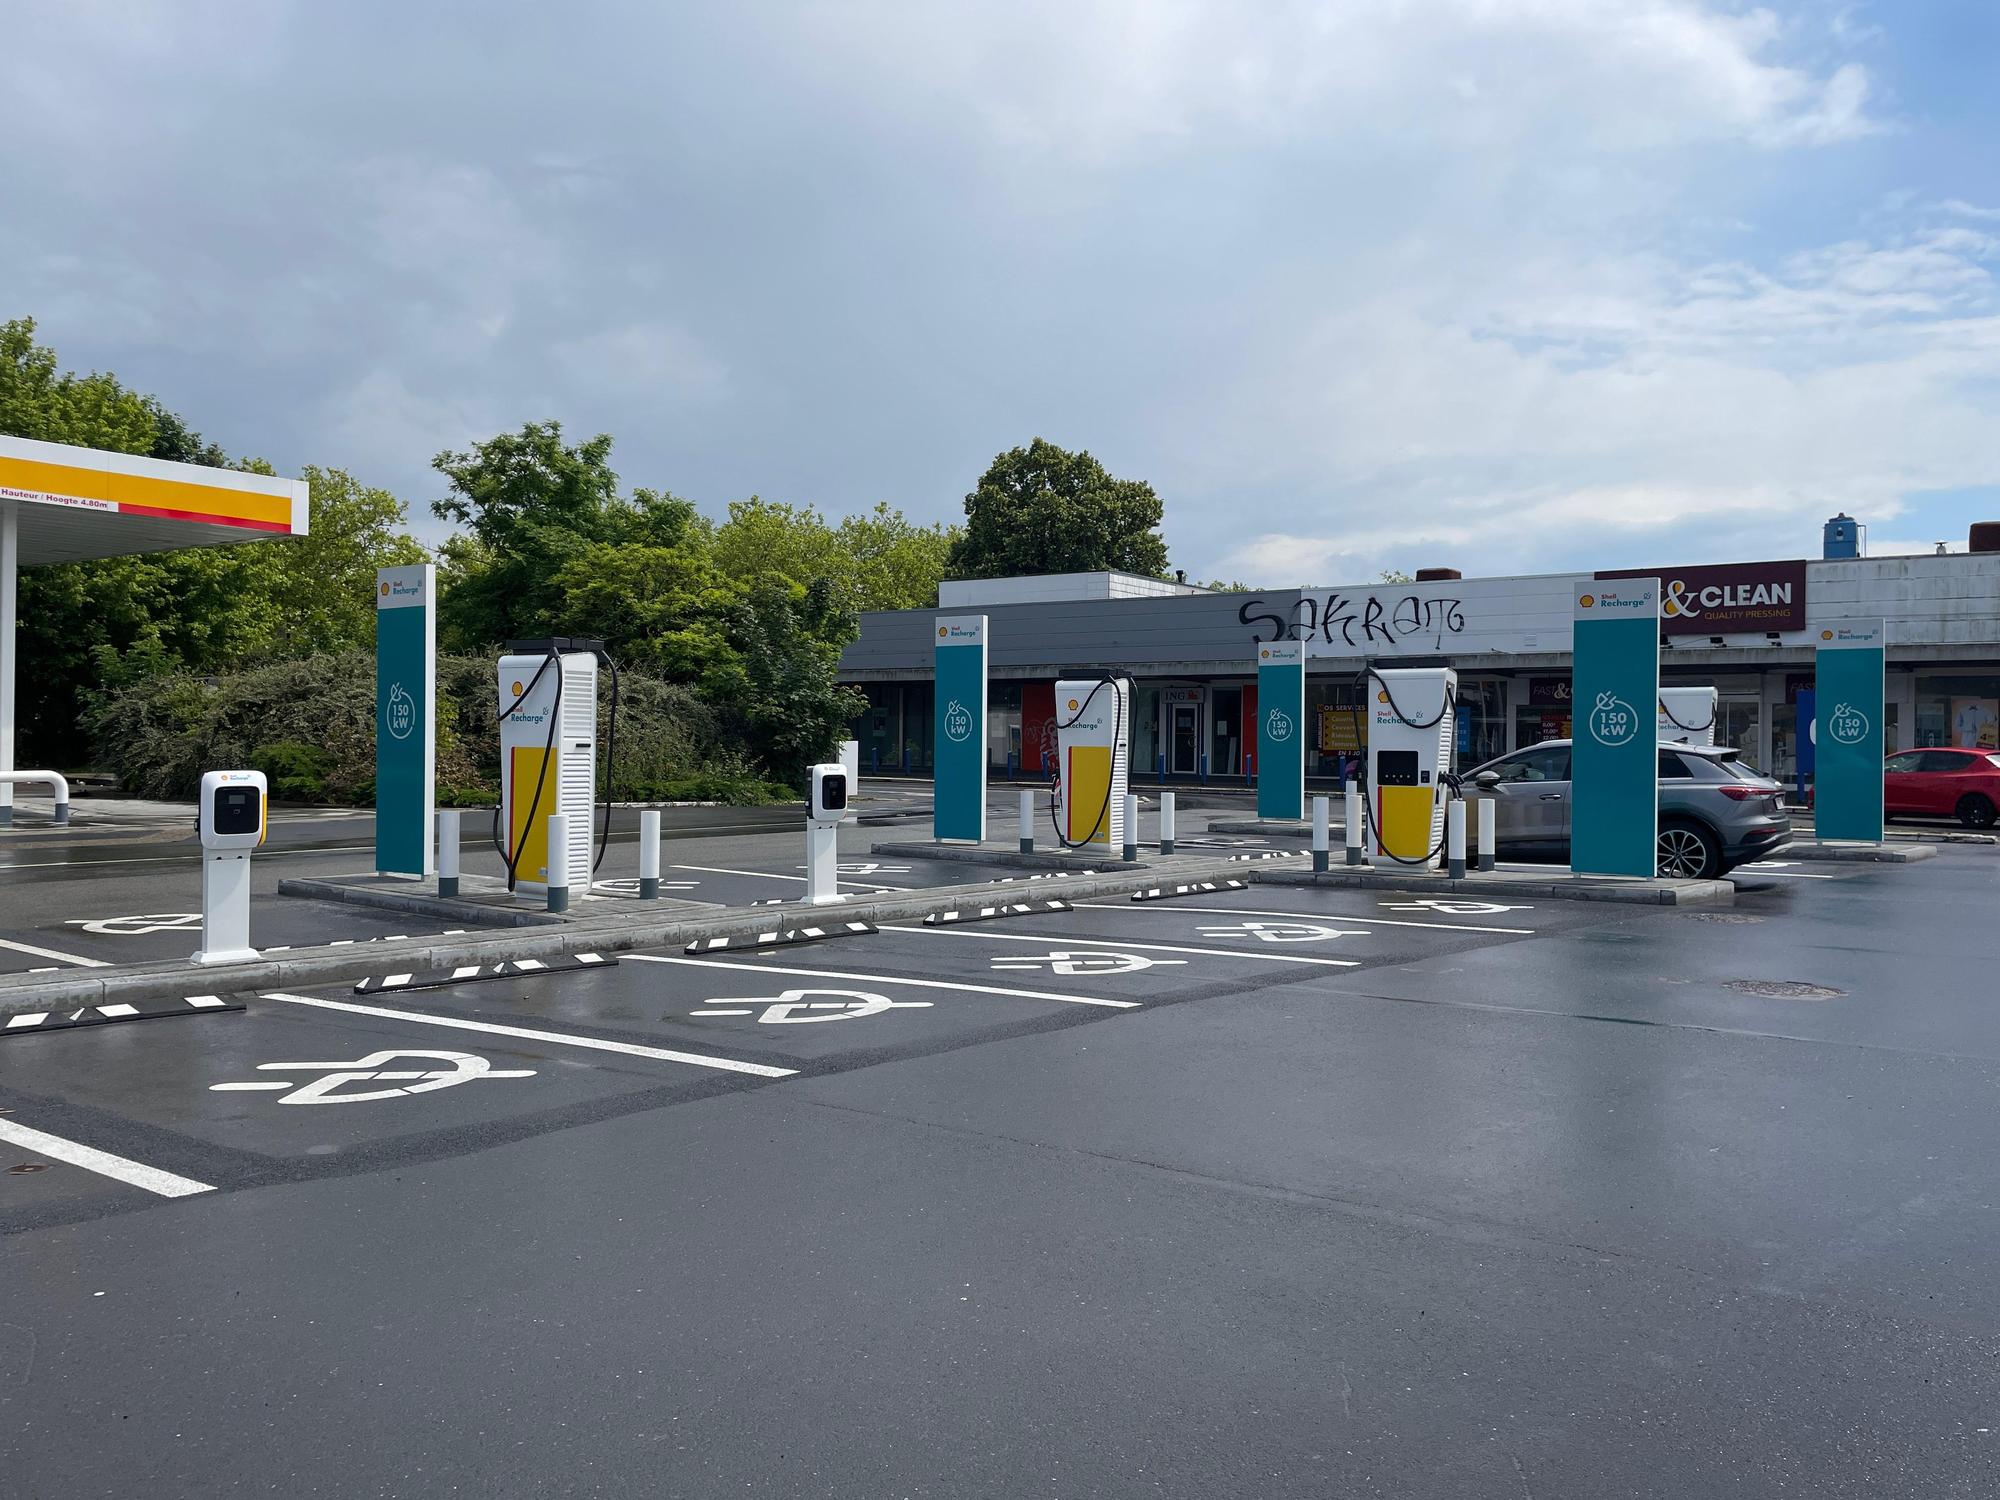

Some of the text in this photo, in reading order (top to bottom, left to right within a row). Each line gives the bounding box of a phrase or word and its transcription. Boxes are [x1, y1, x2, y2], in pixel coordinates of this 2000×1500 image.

[1, 488, 39, 500] Hauteur
[46, 494, 79, 505] Hoogte
[80, 499, 108, 509] 4.80m
[1699, 582, 1792, 608] CLEAN
[1600, 599, 1645, 608] Recharge
[1704, 608, 1791, 620] QUALITY PRESSING
[950, 630, 976, 638] Recharge
[1166, 691, 1185, 700] ING
[393, 704, 409, 716] 150
[393, 716, 409, 729] kW
[511, 712, 544, 724] Recharge
[950, 716, 966, 725] 150
[1600, 712, 1627, 724] 150
[1838, 718, 1860, 727] 150
[1272, 720, 1287, 728] 150
[951, 725, 966, 734] kW
[1272, 728, 1287, 736] kW
[1600, 723, 1627, 736] kW
[1838, 727, 1860, 737] kW
